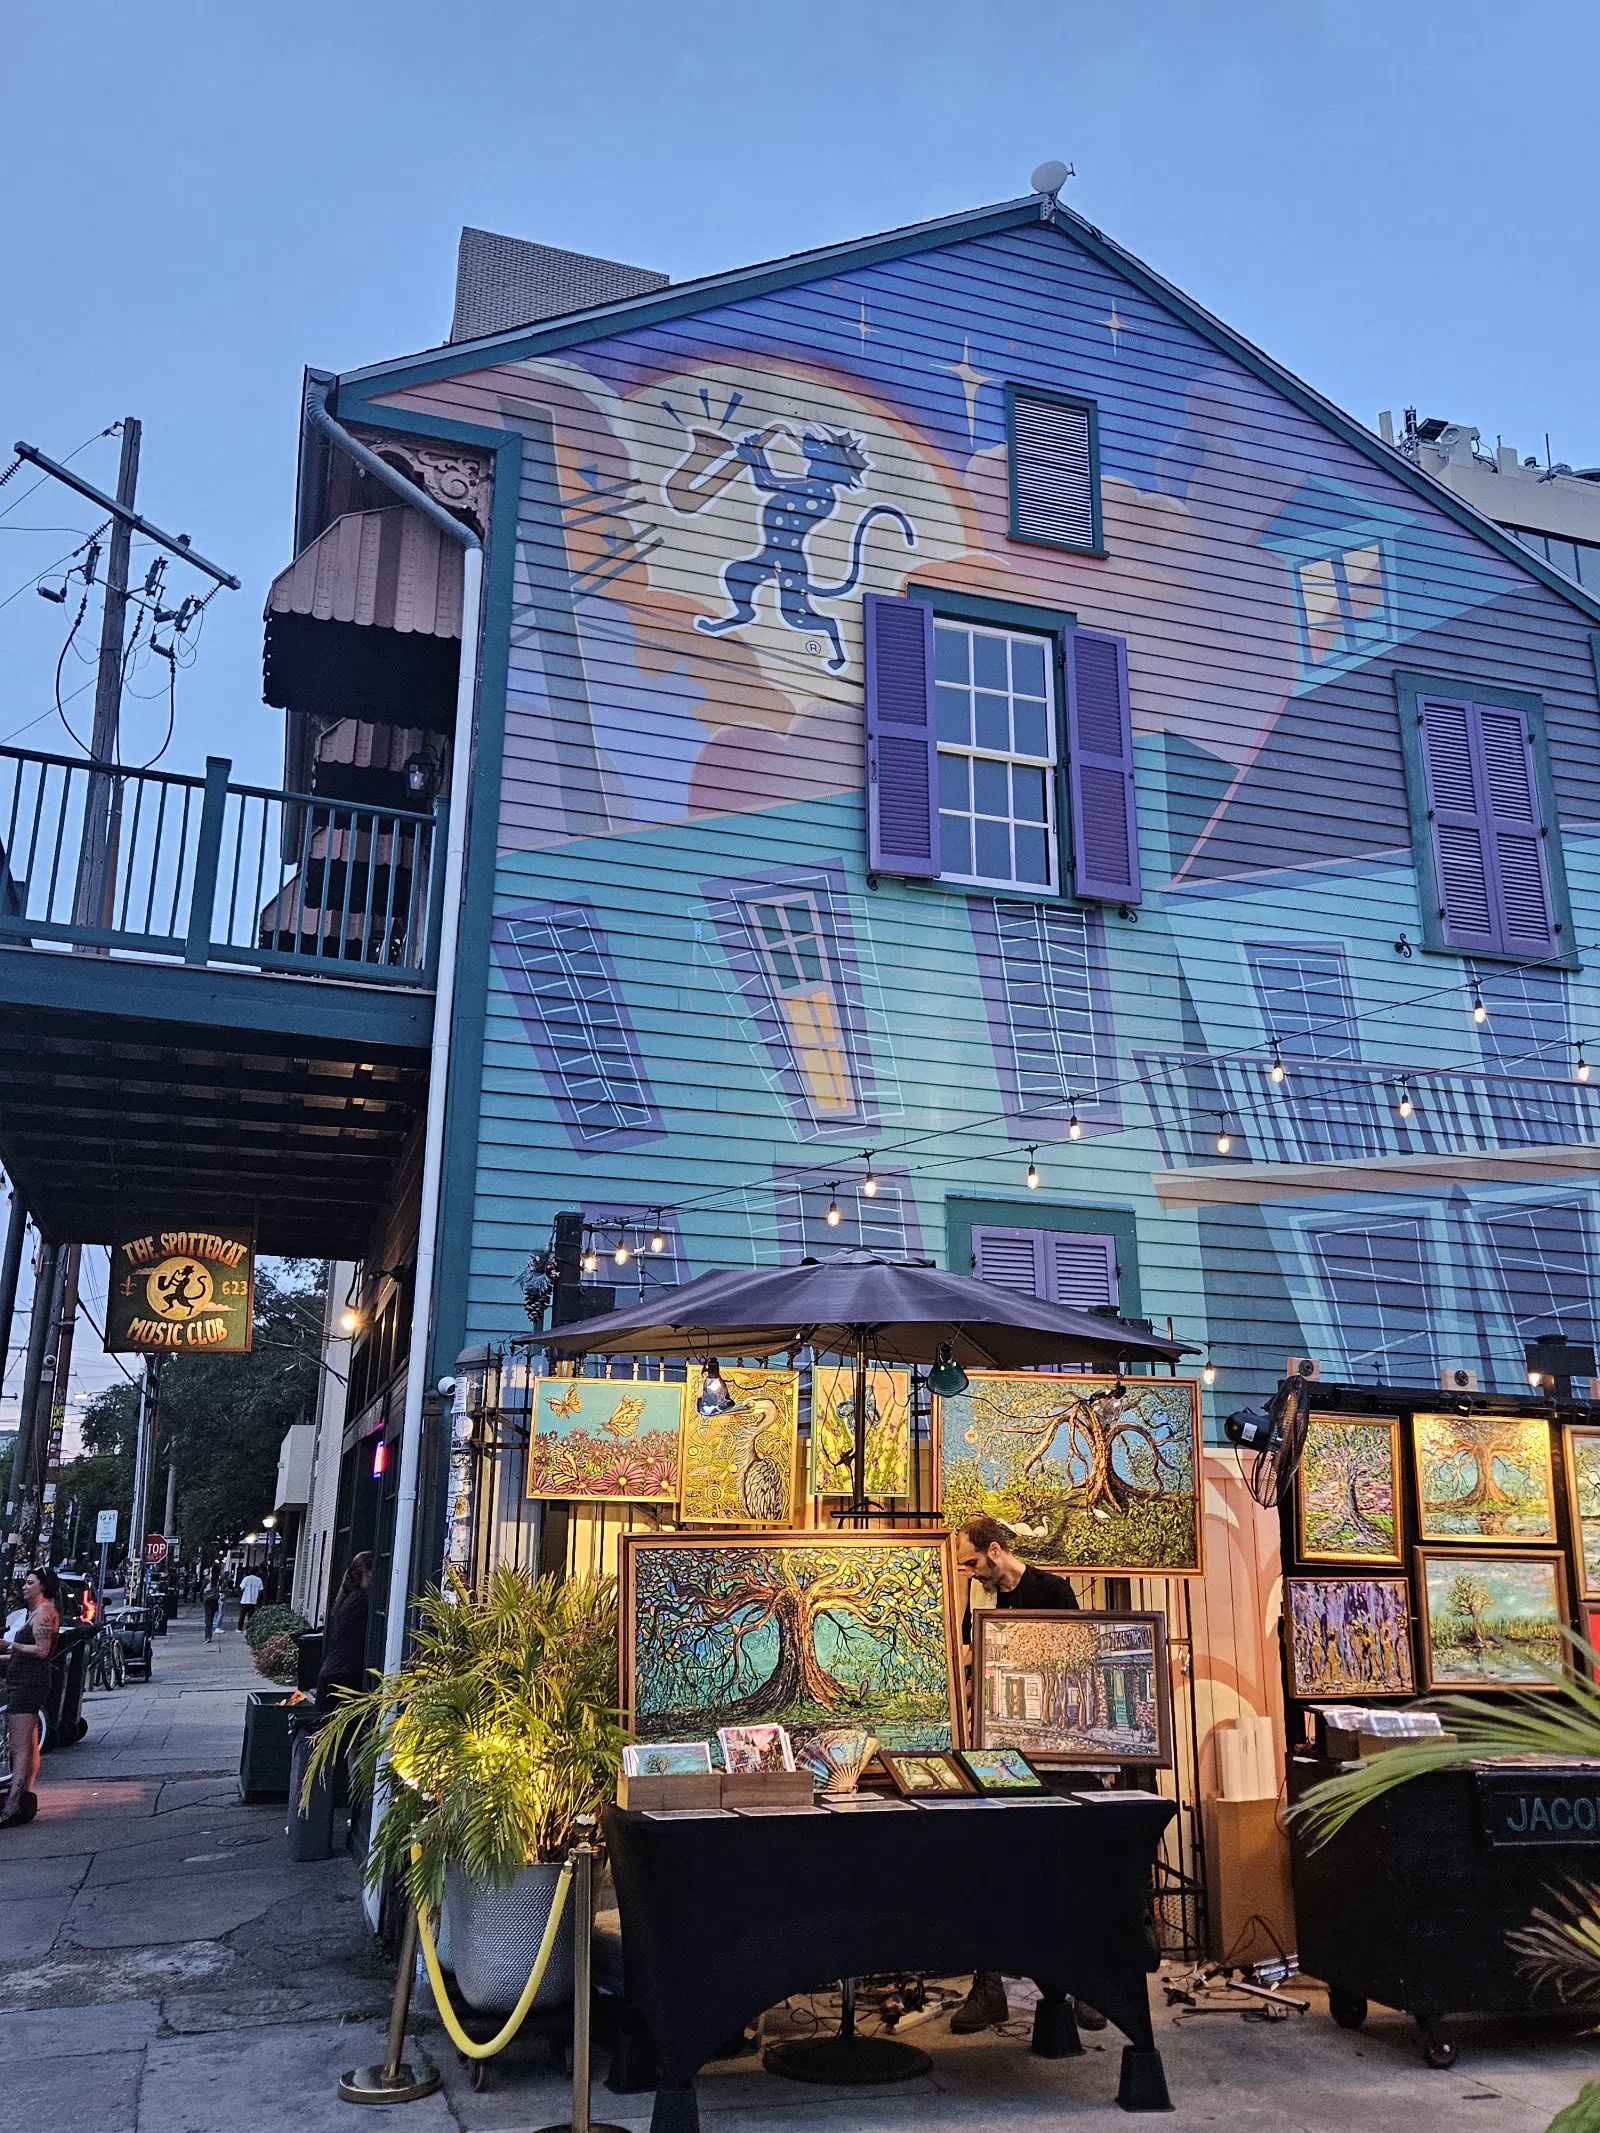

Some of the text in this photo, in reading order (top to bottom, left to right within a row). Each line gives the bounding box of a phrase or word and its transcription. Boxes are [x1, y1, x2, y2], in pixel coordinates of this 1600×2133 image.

[122, 1231, 248, 1268] THE SPOTTED CAT
[222, 1280, 248, 1296] 623
[125, 1317, 229, 1346] MUSIC CLUB
[147, 1543, 166, 1554] TOP
[1507, 1797, 1600, 1831] JACO
